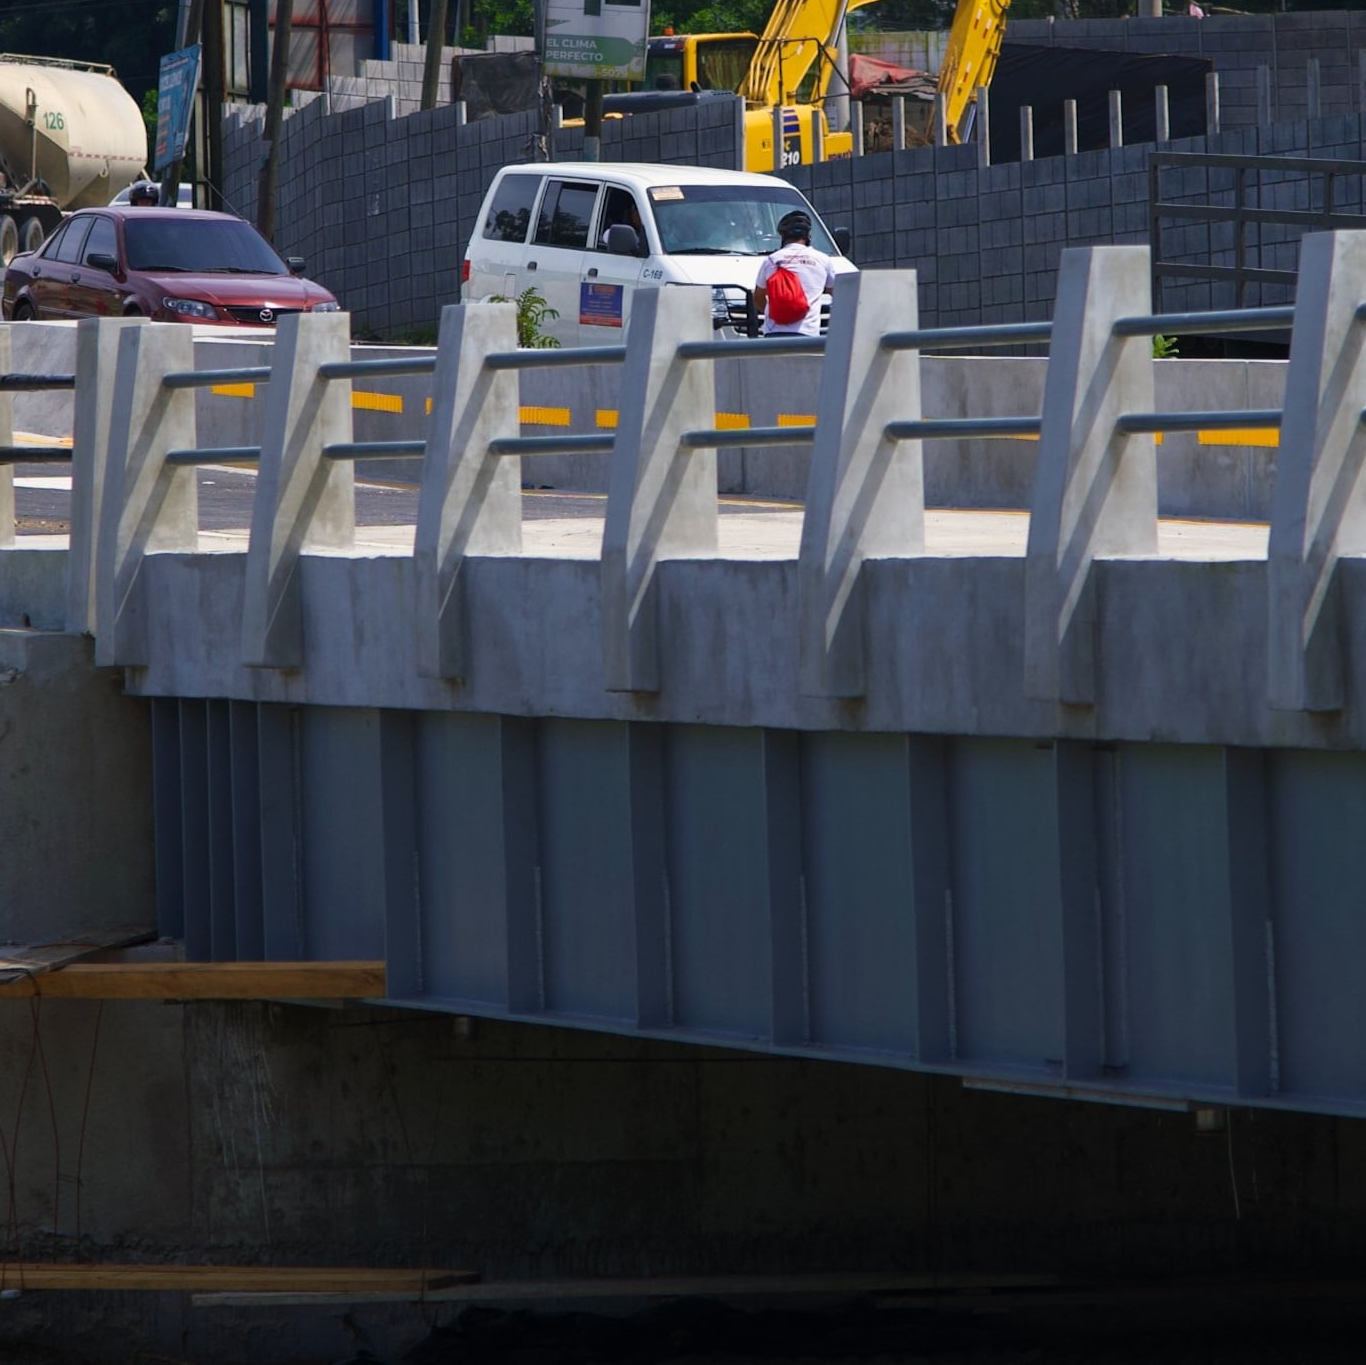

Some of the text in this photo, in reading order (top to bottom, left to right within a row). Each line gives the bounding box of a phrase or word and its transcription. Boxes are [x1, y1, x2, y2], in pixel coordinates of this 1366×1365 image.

[546, 38, 597, 49] EL CLIMA
[545, 50, 603, 62] PERFECTO
[43, 111, 65, 130] 126
